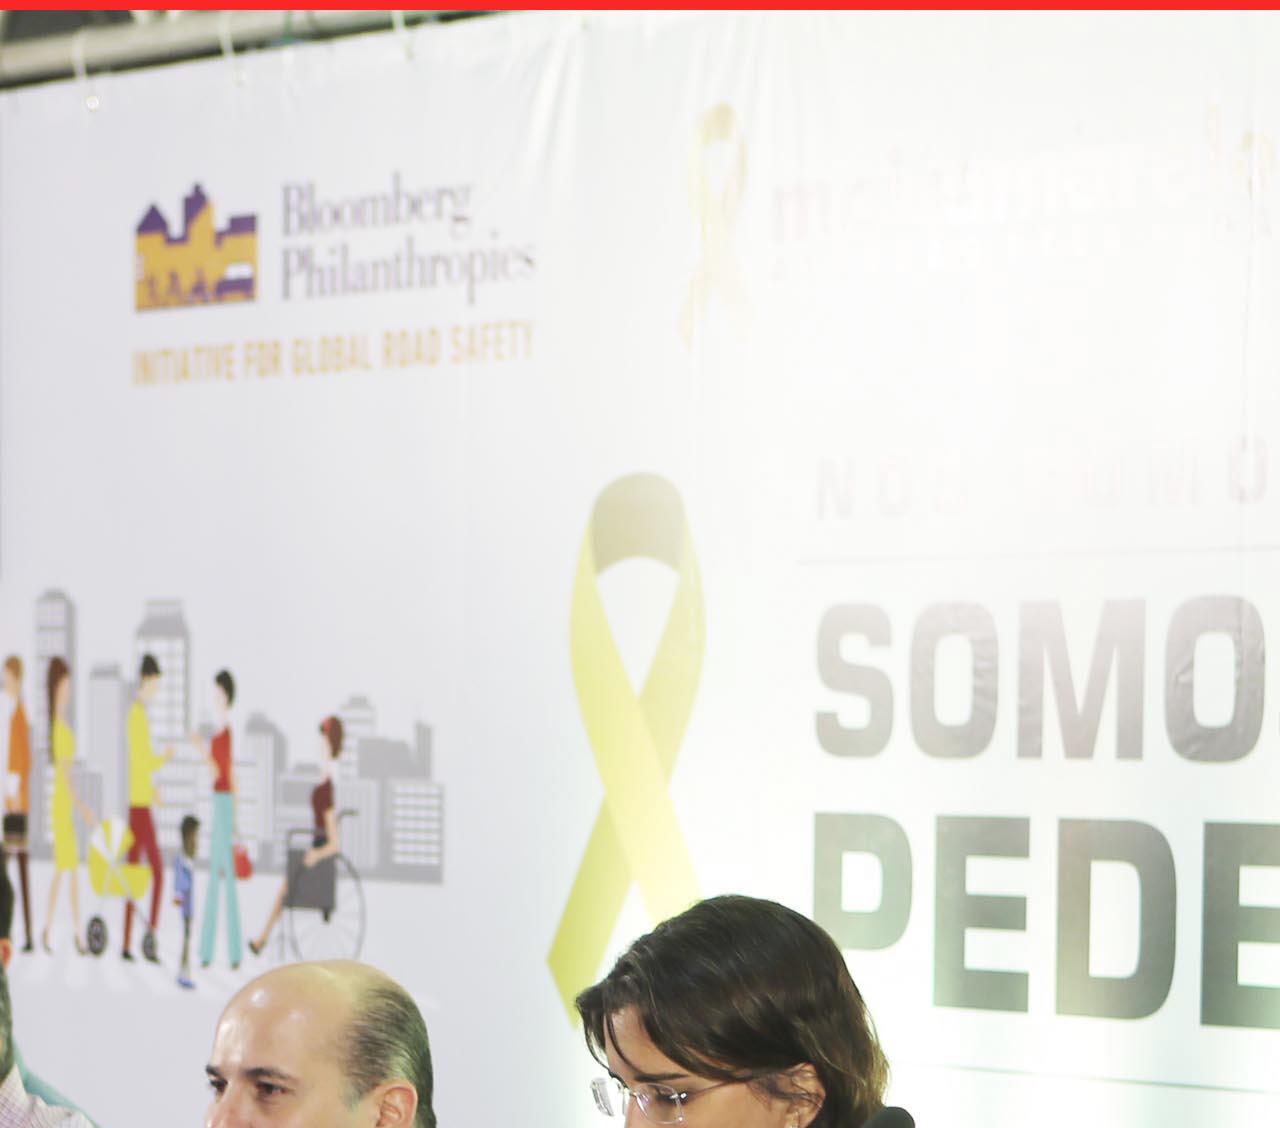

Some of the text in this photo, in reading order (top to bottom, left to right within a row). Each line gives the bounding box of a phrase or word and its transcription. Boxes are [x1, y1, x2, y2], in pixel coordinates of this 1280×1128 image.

[280, 171, 472, 238] Bloomberg
[280, 231, 538, 306] Philanthropies
[133, 320, 536, 386] INITIATIVE FOR GLOBAL ROAD SAFETY
